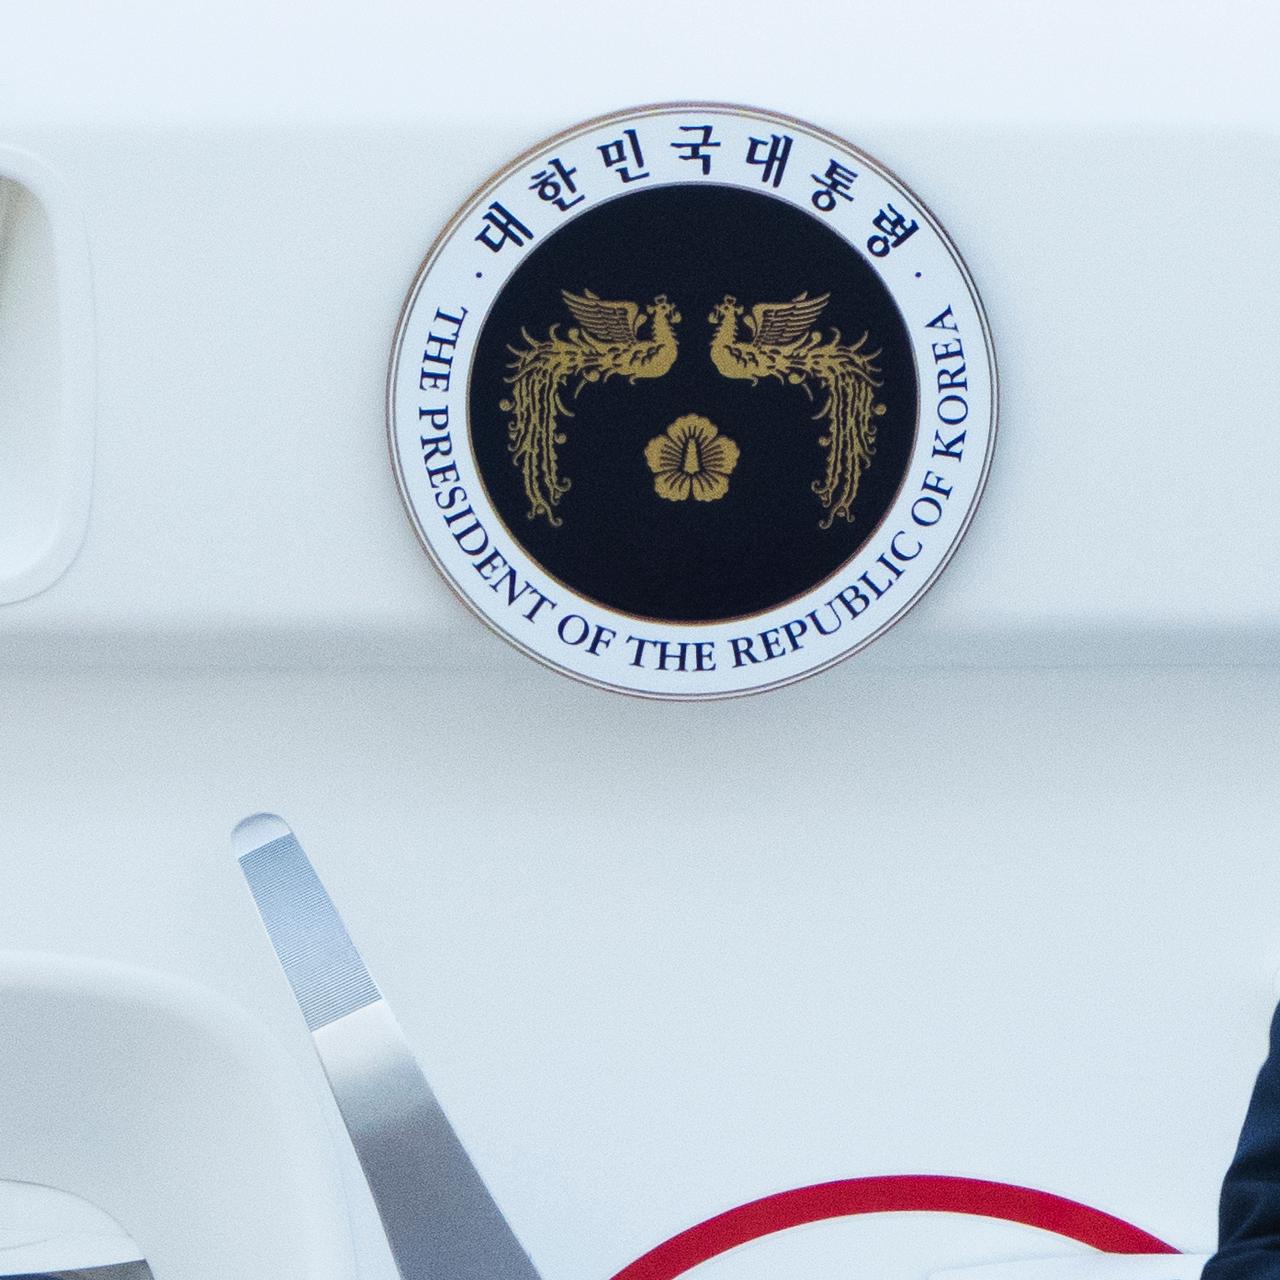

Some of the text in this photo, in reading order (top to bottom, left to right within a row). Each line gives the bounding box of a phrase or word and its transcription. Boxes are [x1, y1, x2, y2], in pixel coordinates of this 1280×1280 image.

[418, 304, 969, 672] THE PRESIDENT OF THE REPUBLIC OF KOREA
